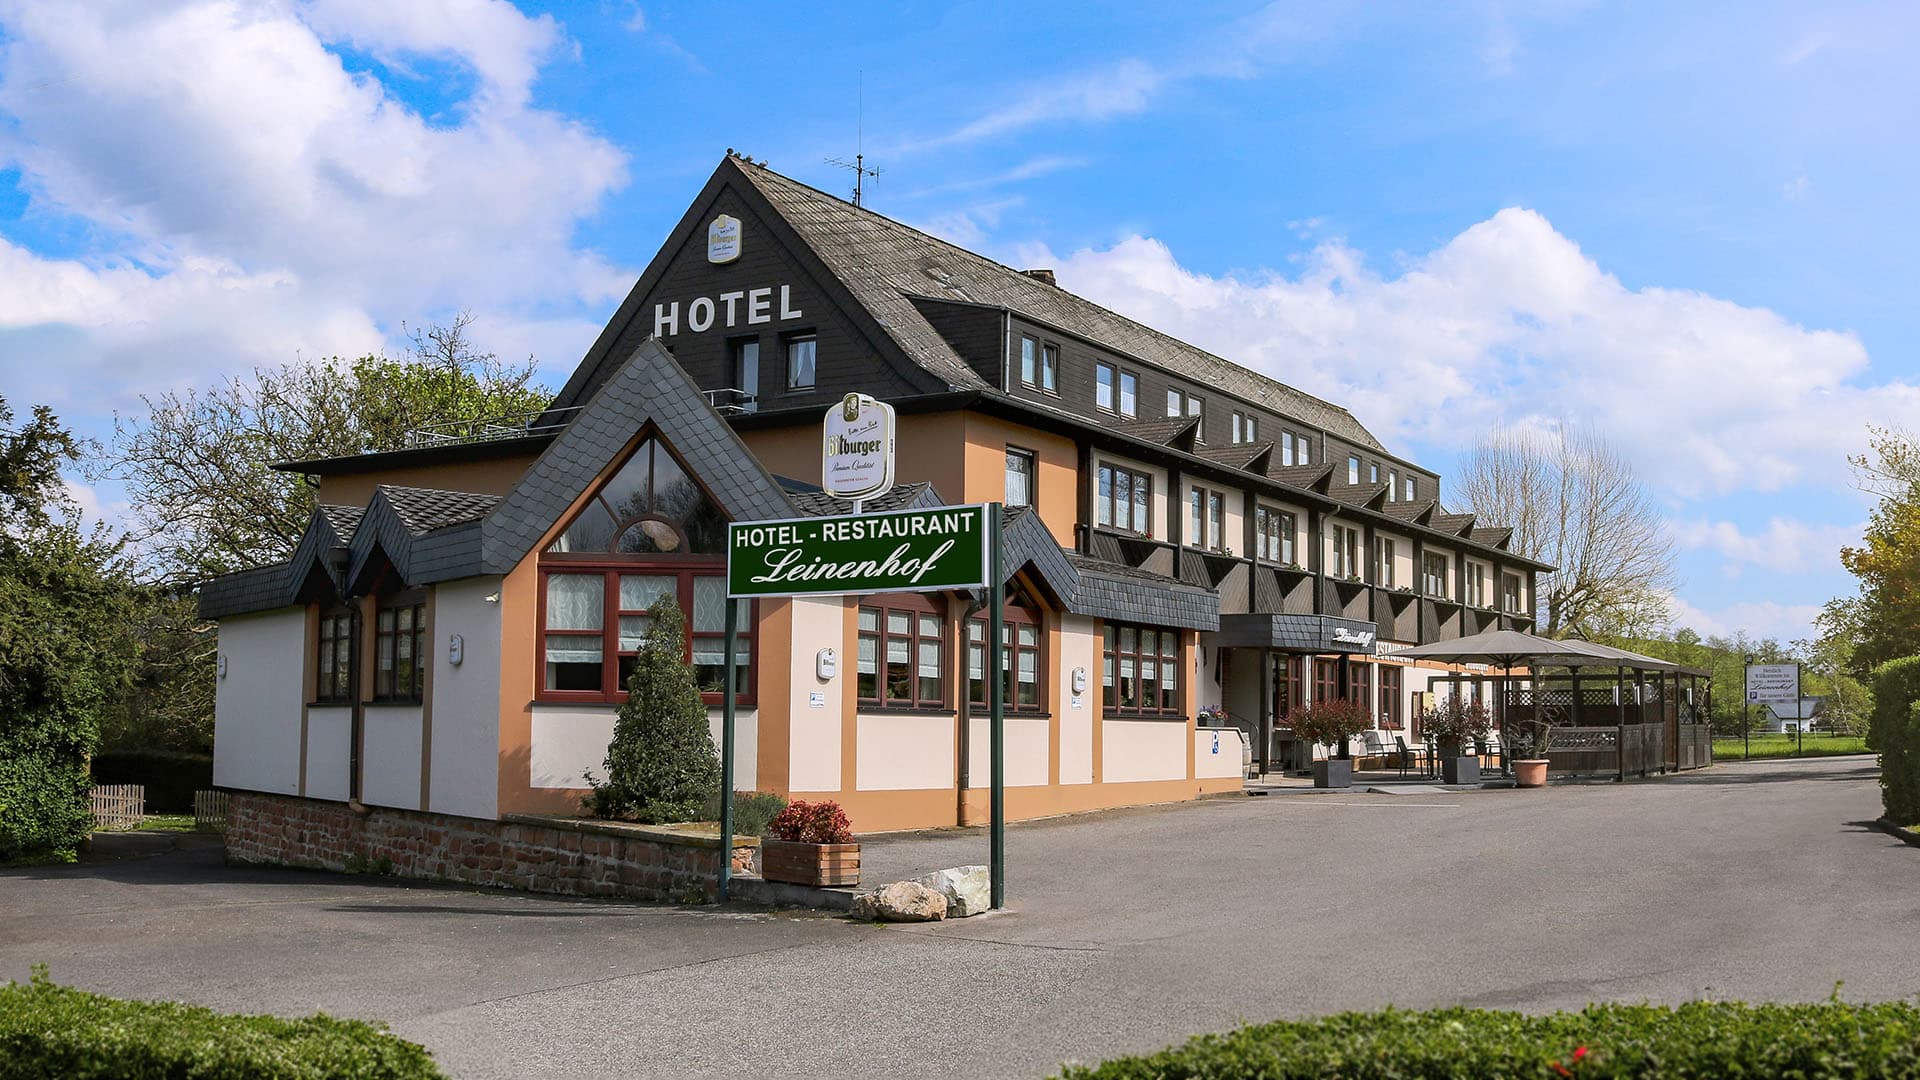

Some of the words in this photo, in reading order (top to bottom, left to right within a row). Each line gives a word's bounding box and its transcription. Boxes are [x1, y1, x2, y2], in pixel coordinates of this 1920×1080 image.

[654, 284, 802, 338] HOTEL
[828, 434, 882, 456] Bitburger
[736, 525, 804, 548] HOTEL
[822, 512, 975, 542] RESTAURANT
[750, 539, 955, 583] Leinenhof
